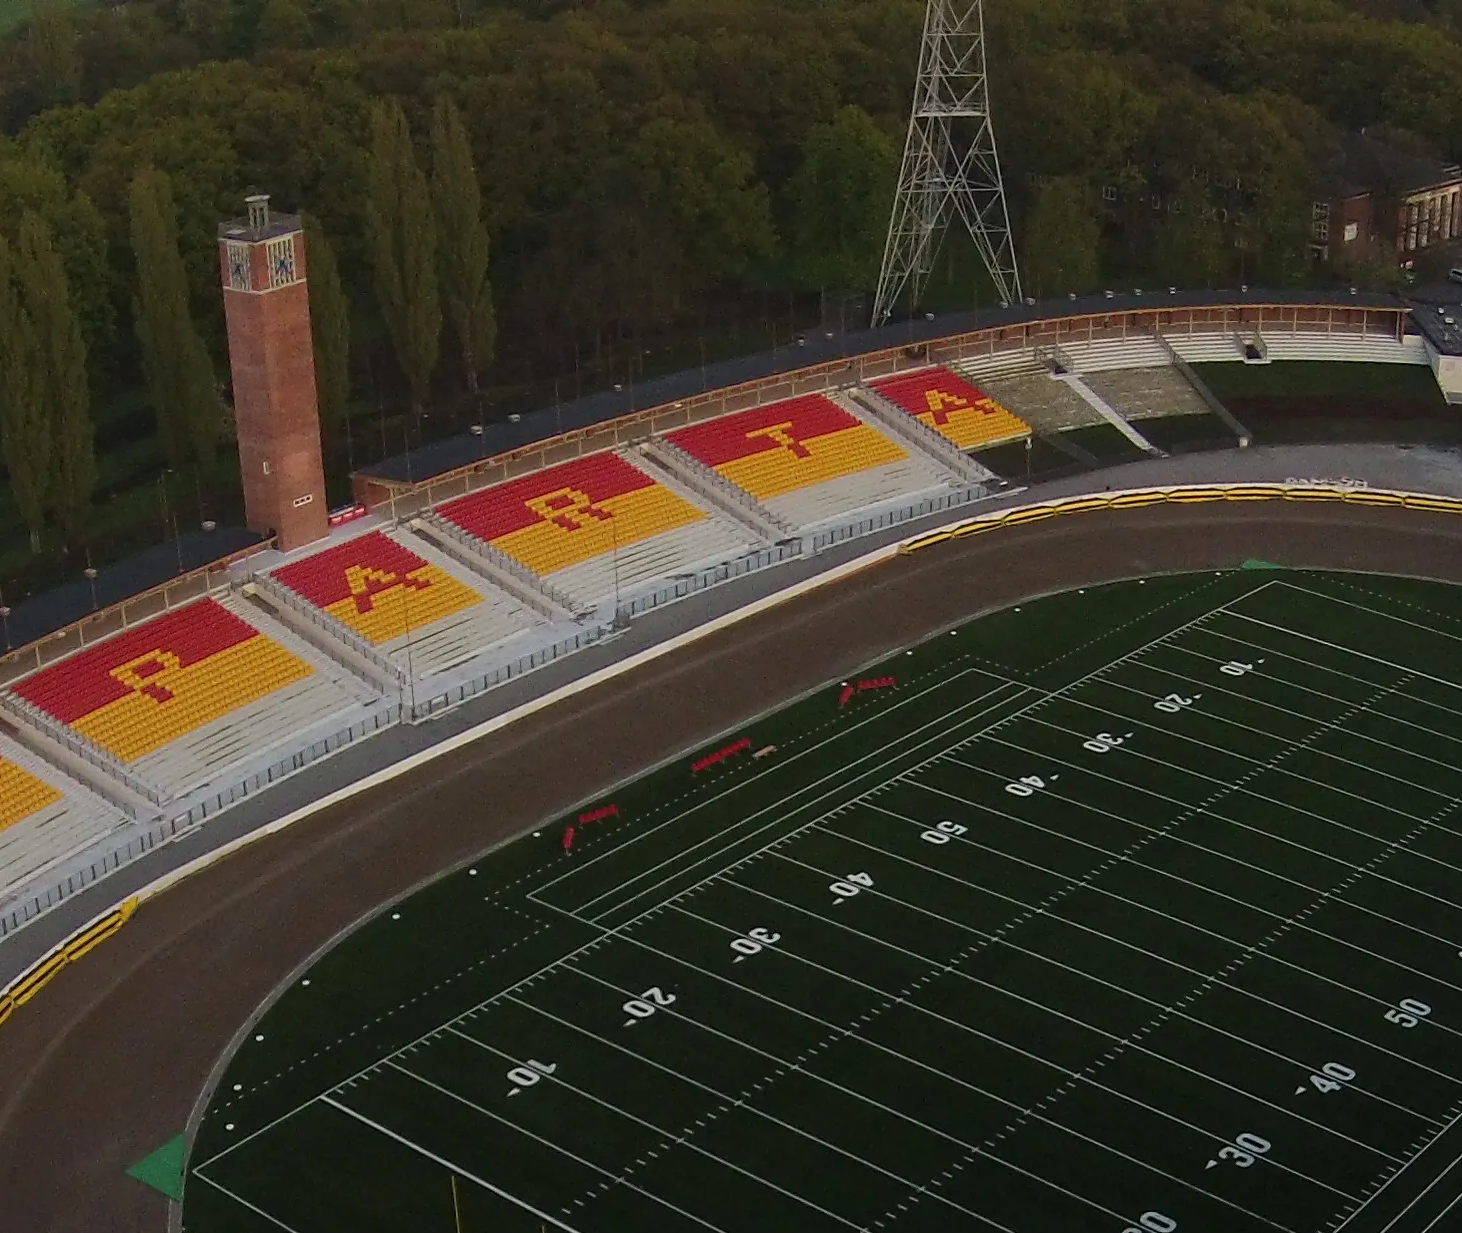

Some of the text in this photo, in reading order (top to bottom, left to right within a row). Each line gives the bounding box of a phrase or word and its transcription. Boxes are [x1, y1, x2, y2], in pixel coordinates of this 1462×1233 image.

[1219, 659, 1254, 677] 10
[1153, 692, 1193, 713] 20
[1082, 732, 1125, 754] 30
[1005, 774, 1046, 798] 40
[920, 818, 968, 845] 50
[829, 869, 875, 899] 40
[729, 925, 781, 957] 30
[622, 985, 677, 1021] 20
[1384, 997, 1433, 1029] 50
[505, 1057, 557, 1089] 10
[1307, 1060, 1356, 1096] 40
[1218, 1131, 1272, 1169] 30
